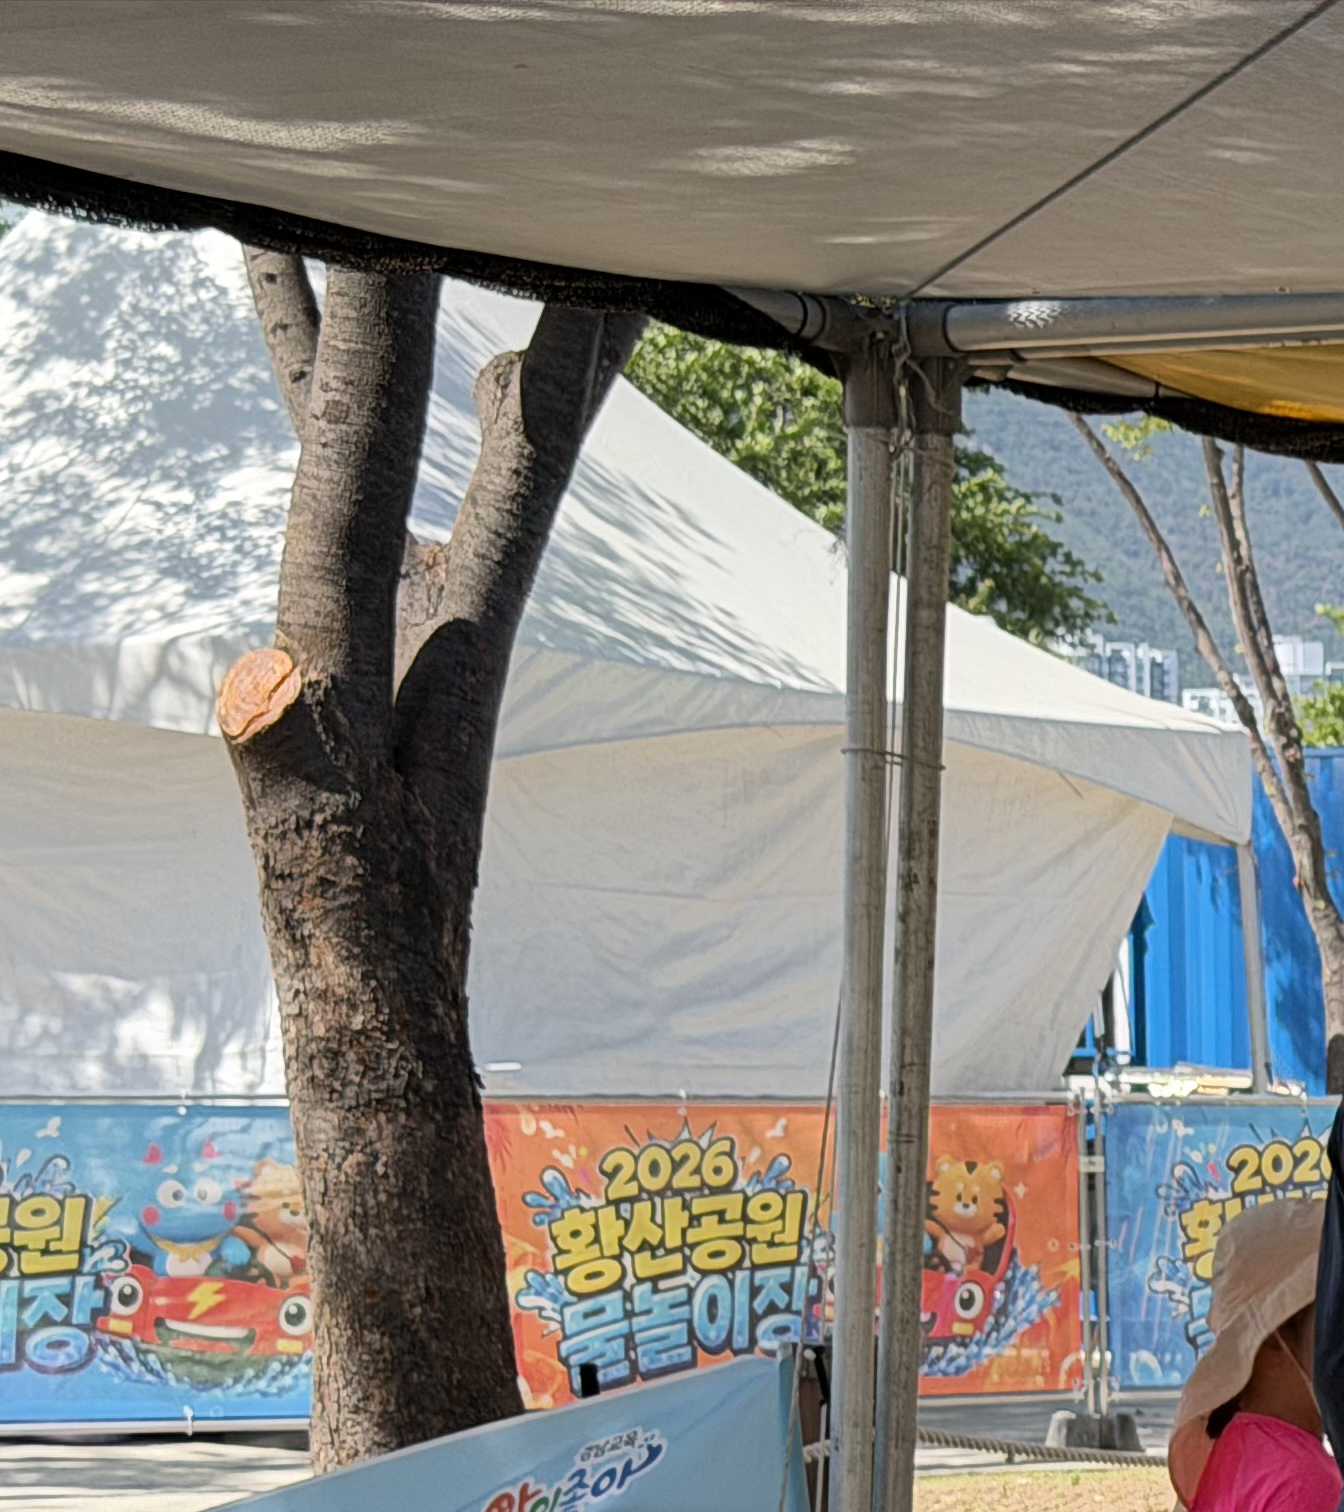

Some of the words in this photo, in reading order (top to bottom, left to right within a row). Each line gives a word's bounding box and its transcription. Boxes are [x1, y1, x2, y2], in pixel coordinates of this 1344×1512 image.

[601, 1138, 736, 1201] 2026
[1228, 1136, 1332, 1193] 202
[551, 1190, 804, 1294] 황산공원
[559, 1267, 819, 1394] 물놀이장
